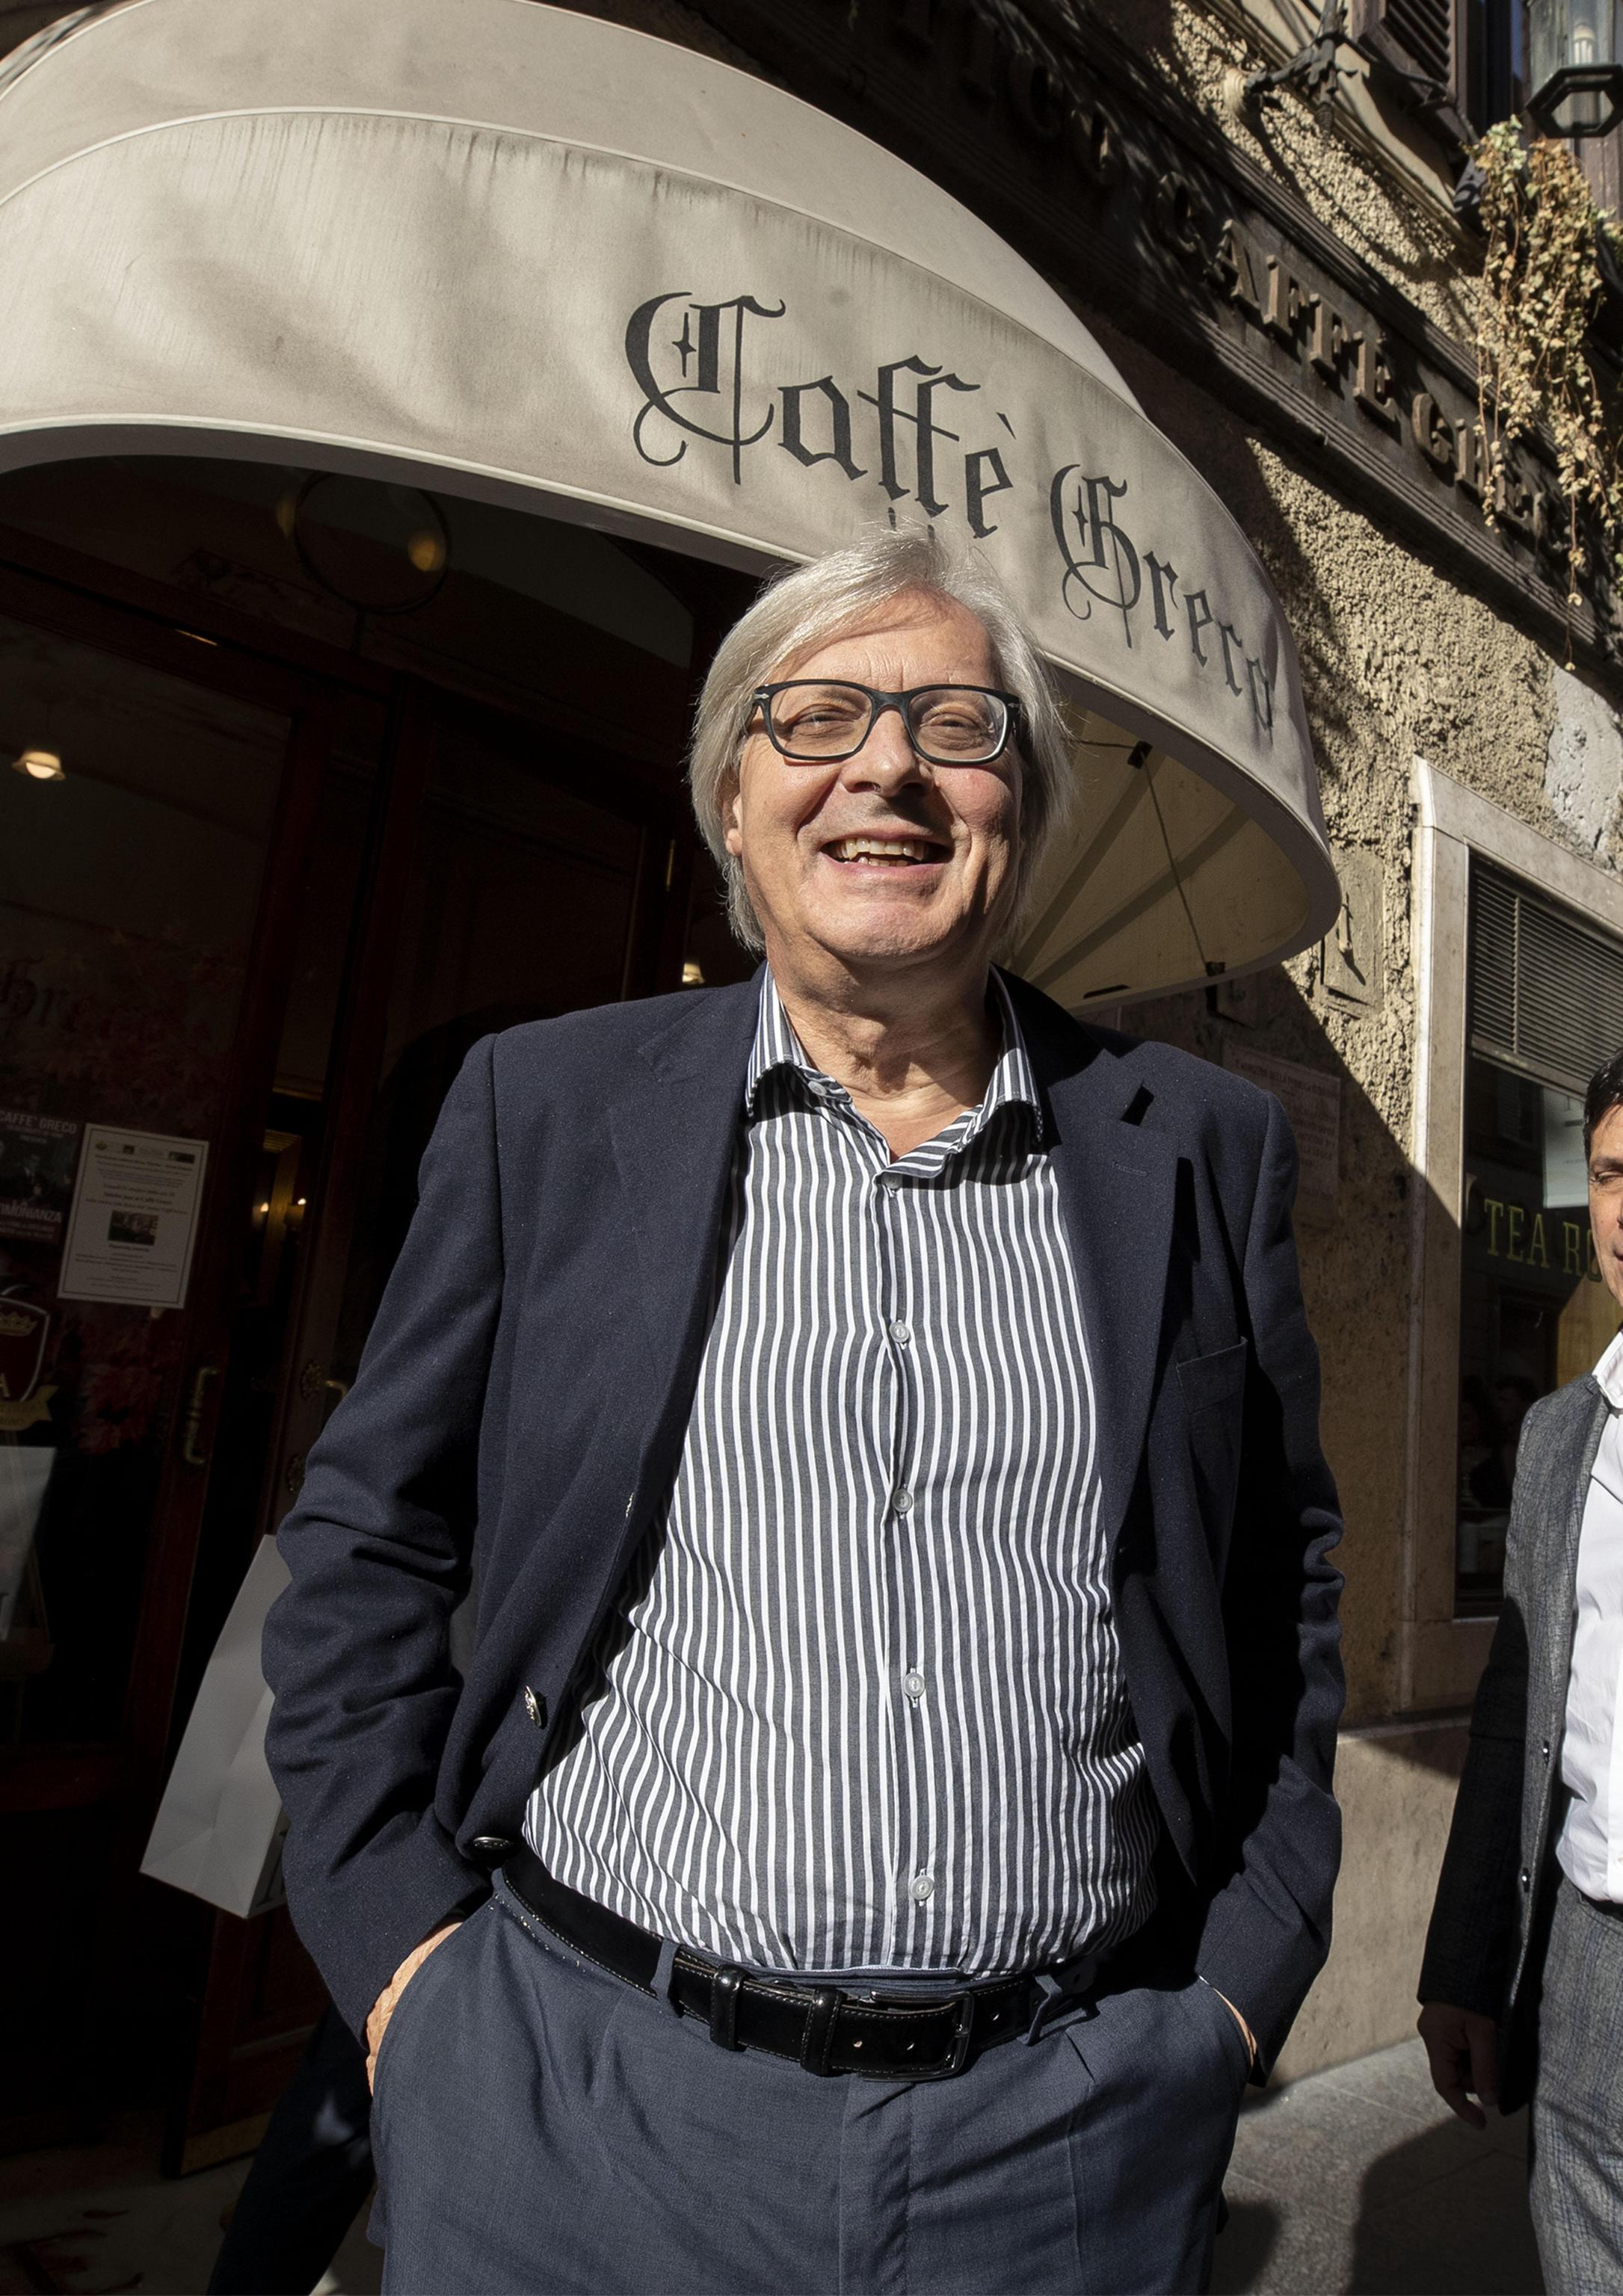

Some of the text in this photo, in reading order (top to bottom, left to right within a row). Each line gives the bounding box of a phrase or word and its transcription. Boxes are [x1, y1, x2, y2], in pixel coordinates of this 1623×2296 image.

[625, 291, 1275, 731] Caffè Greco
[39, 1117, 77, 1134] GRECO
[1484, 1198, 1550, 1268] TEA
